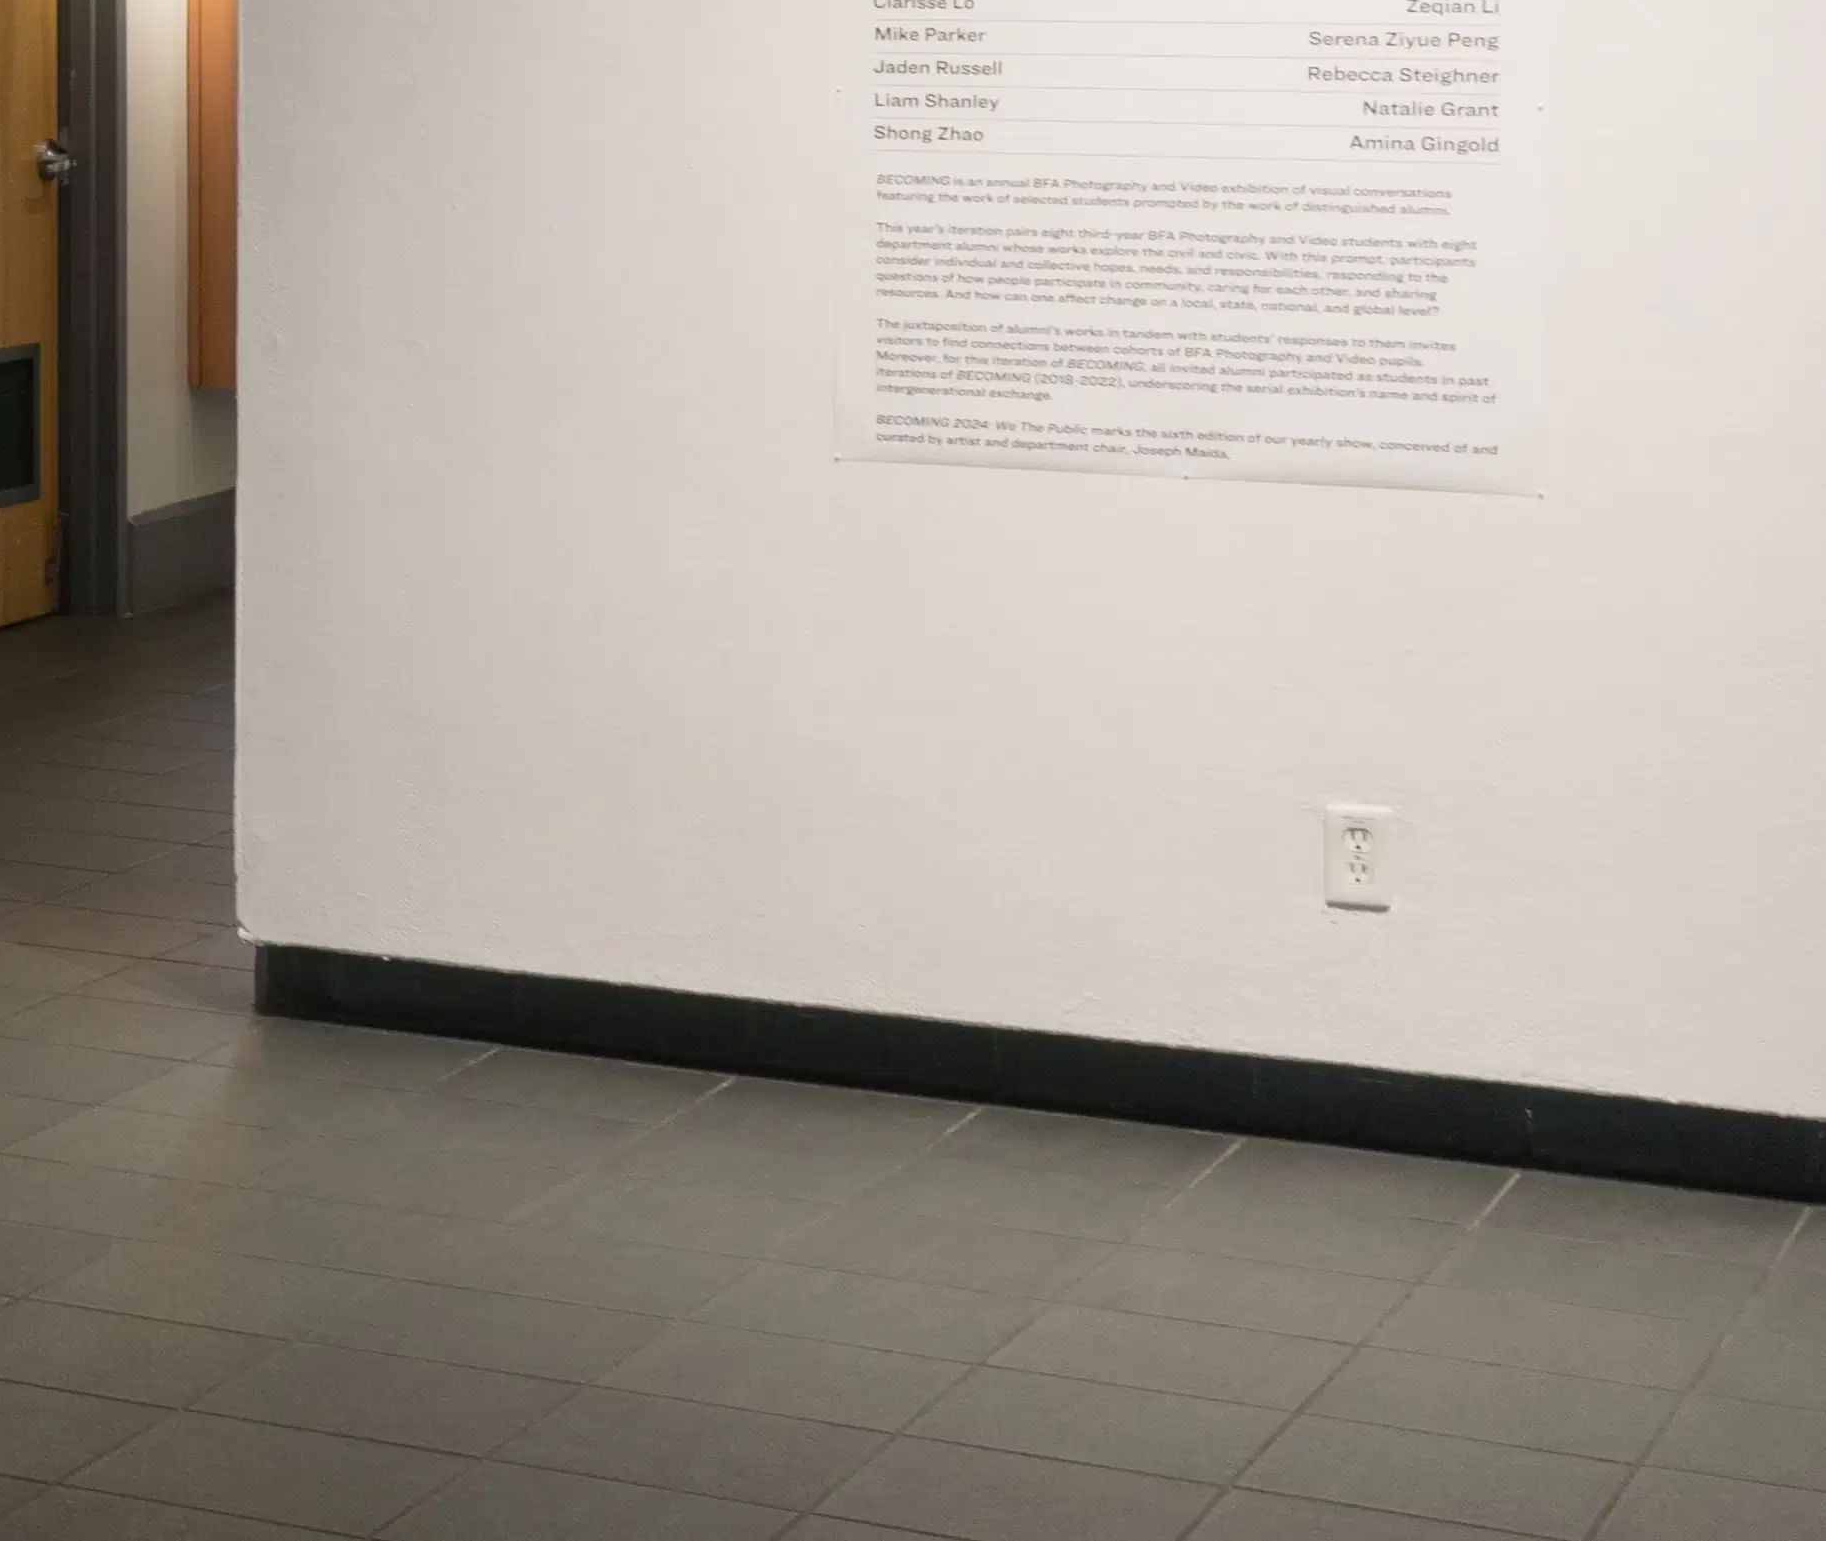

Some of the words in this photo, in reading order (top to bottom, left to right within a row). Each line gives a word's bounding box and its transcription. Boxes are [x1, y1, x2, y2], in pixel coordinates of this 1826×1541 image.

[874, 26, 919, 41] Mike
[924, 27, 986, 42] Parker
[1308, 31, 1379, 46] Serena
[1384, 31, 1441, 49] Ziyue
[1447, 32, 1499, 51] Peng
[872, 59, 930, 74] Jaden
[935, 60, 1002, 75] Russell
[1307, 65, 1393, 82] Rebecca
[1398, 67, 1500, 86] Steighner
[874, 92, 919, 107] Liam
[924, 93, 998, 111] Shanley
[1362, 100, 1434, 116] Natalie
[1440, 101, 1498, 117] Grant
[873, 125, 932, 143] Shong
[936, 126, 984, 141] Zhao
[1349, 134, 1415, 150] Amina
[1420, 136, 1499, 155] Gingold
